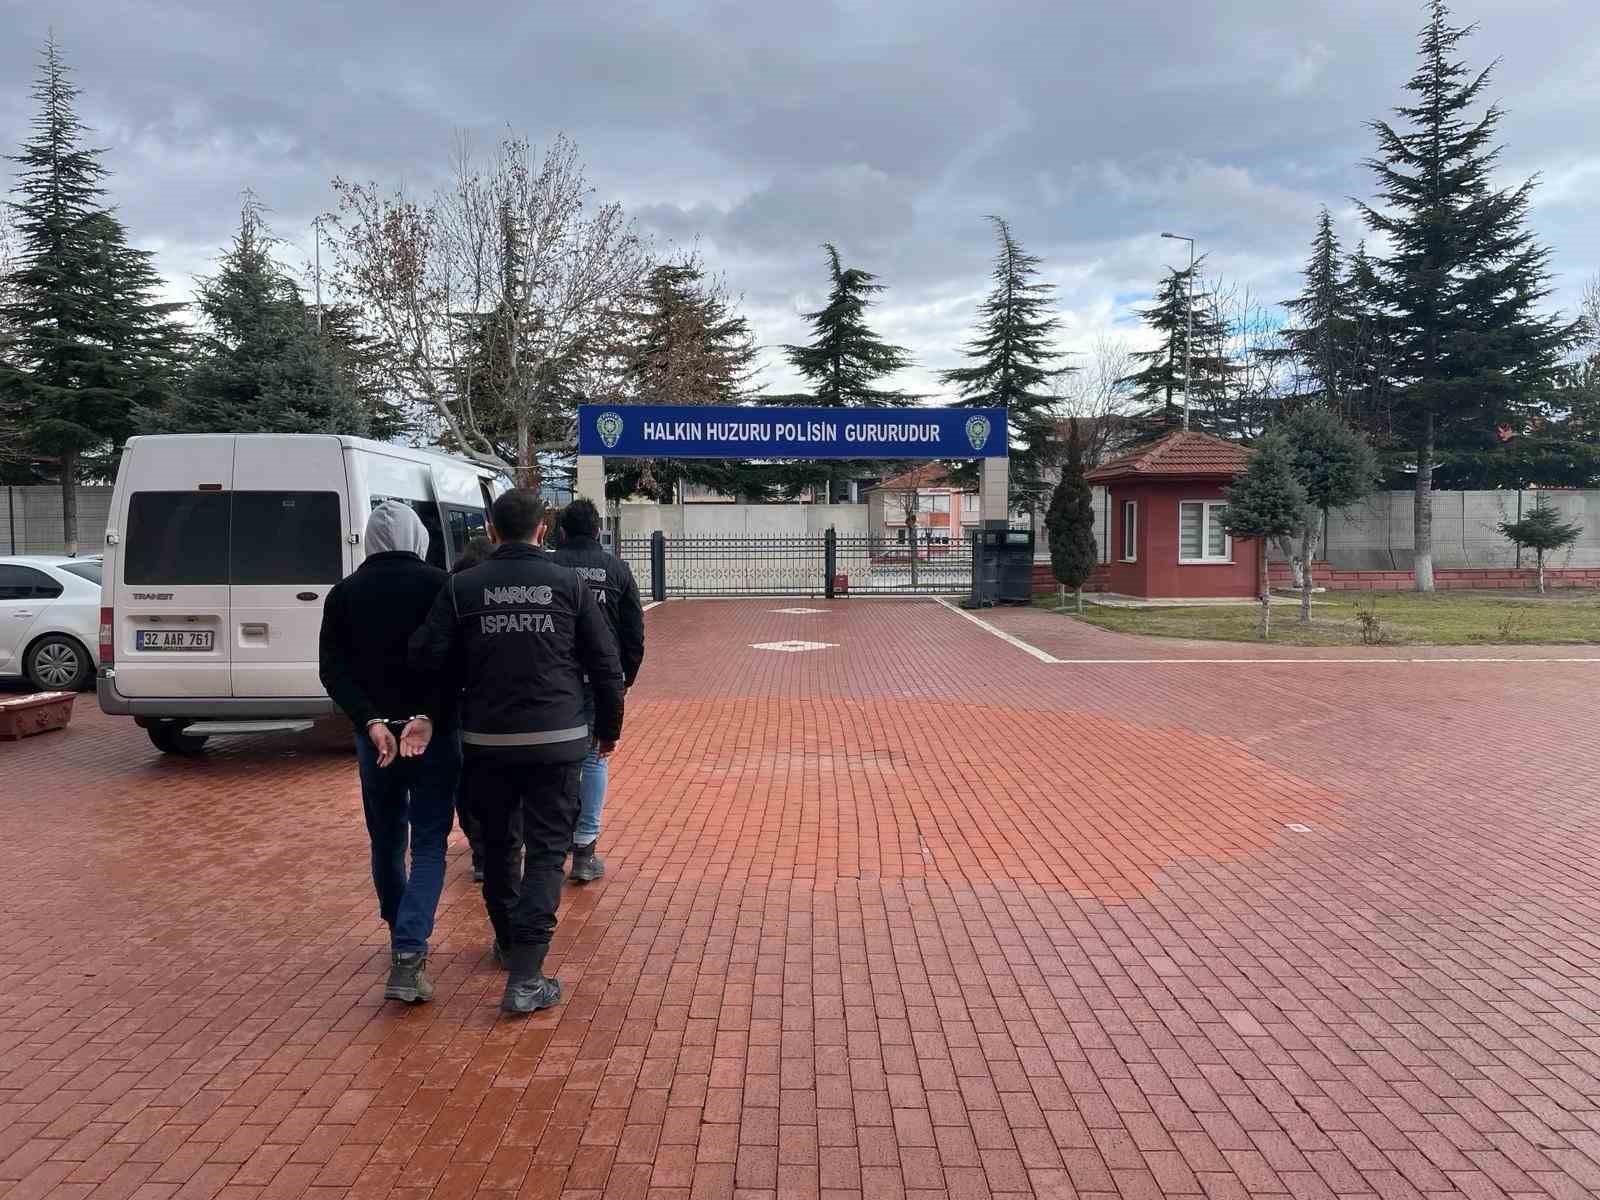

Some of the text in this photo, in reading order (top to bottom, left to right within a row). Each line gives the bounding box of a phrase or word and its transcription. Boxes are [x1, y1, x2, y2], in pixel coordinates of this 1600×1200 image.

[644, 421, 940, 442] HALKIN HUZURU POLİSİN GURURUDUR
[480, 613, 555, 634] ISPARTA
[144, 632, 209, 646] 32 AAR 761
